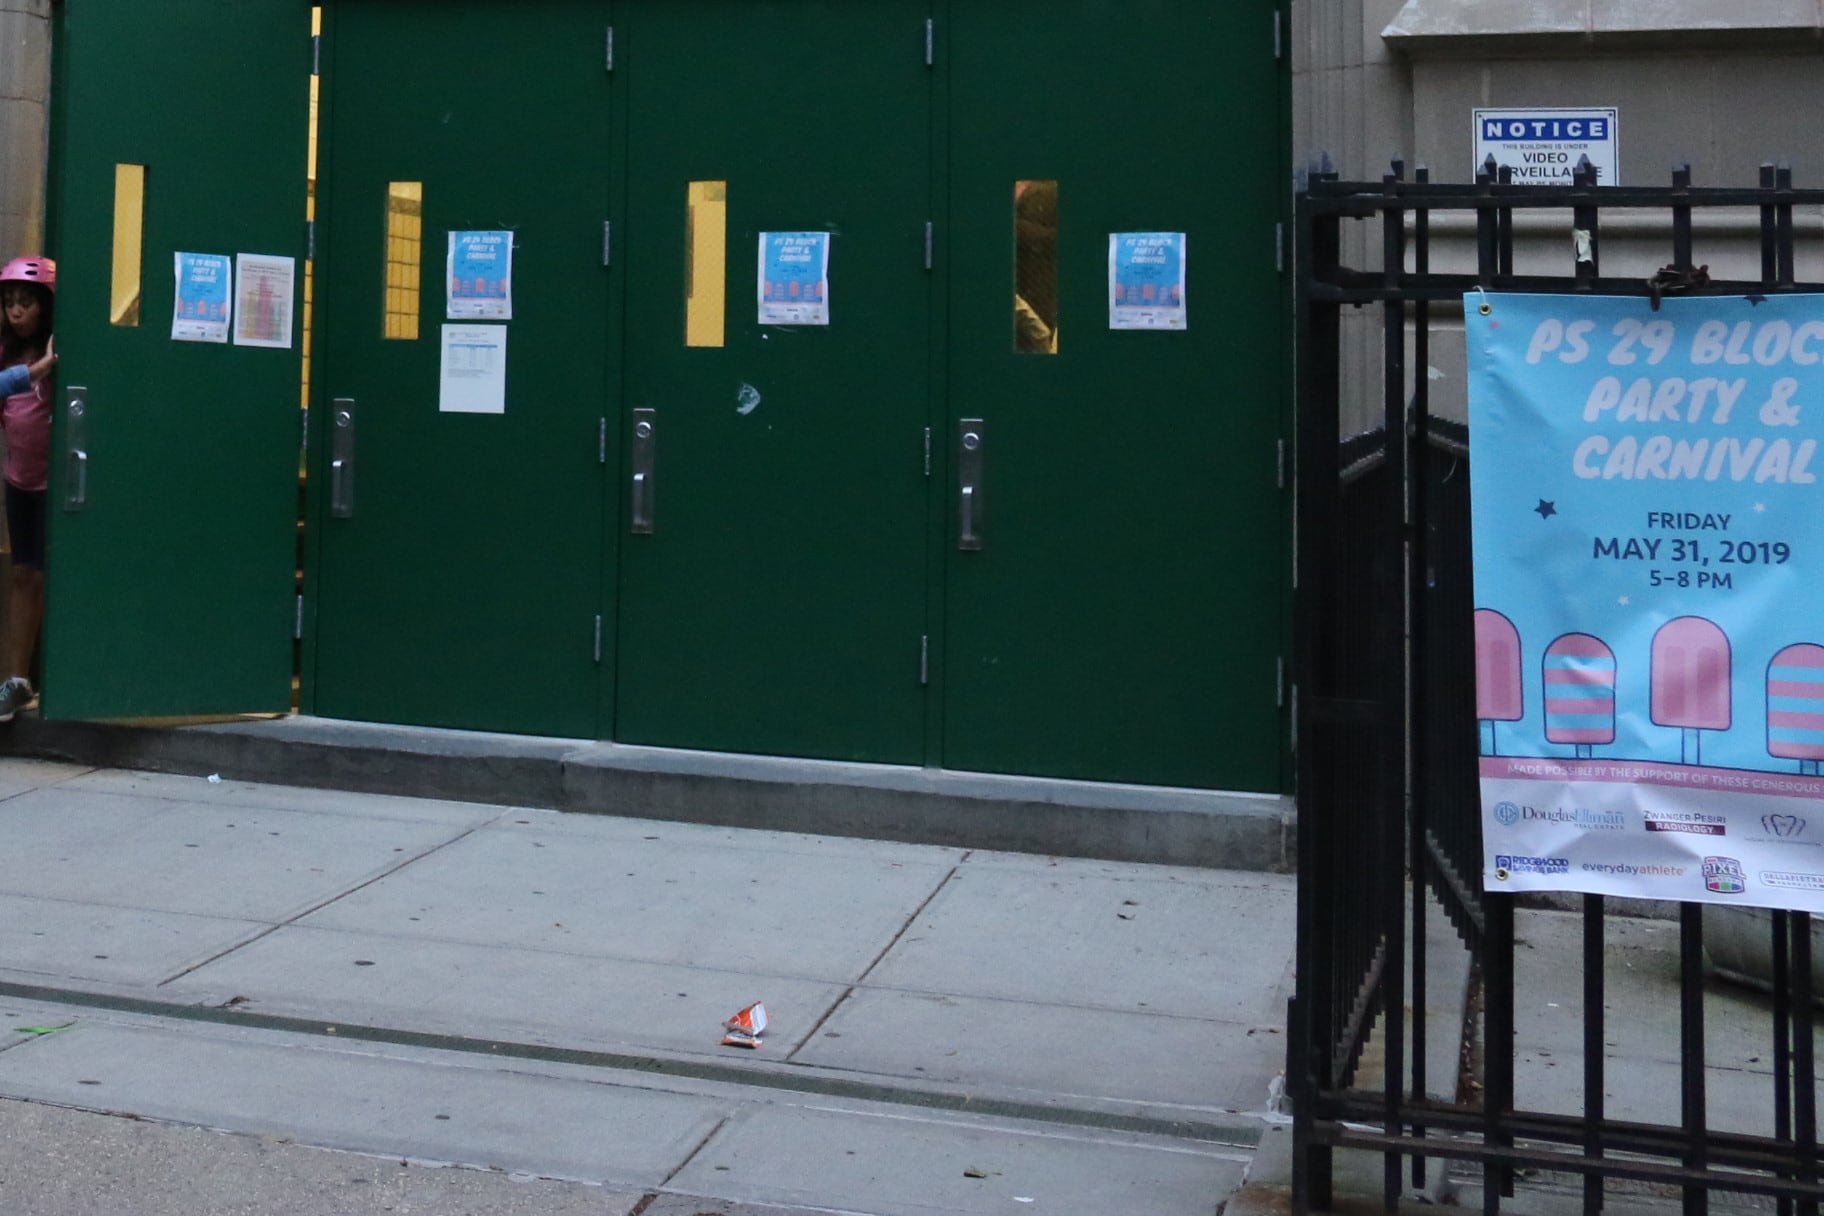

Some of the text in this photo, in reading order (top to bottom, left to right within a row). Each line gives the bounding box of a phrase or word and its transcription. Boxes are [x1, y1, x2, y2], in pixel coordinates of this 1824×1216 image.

[1487, 121, 1603, 137] NOTICE
[1523, 152, 1569, 163] VIDEO
[1526, 318, 1824, 366] PS 29 BLOC
[1583, 376, 1801, 427] PARTY &
[1573, 435, 1817, 484] CARNIVAL
[1647, 511, 1732, 531] FRIDAY
[1593, 536, 1791, 567] MAY 31, 2019
[1697, 571, 1733, 590] PM
[1508, 765, 1820, 793] MADE POSSIBLE BY THE SUPPORT OF THESE GENEROUS
[1656, 822, 1714, 834] RADIOLOGY
